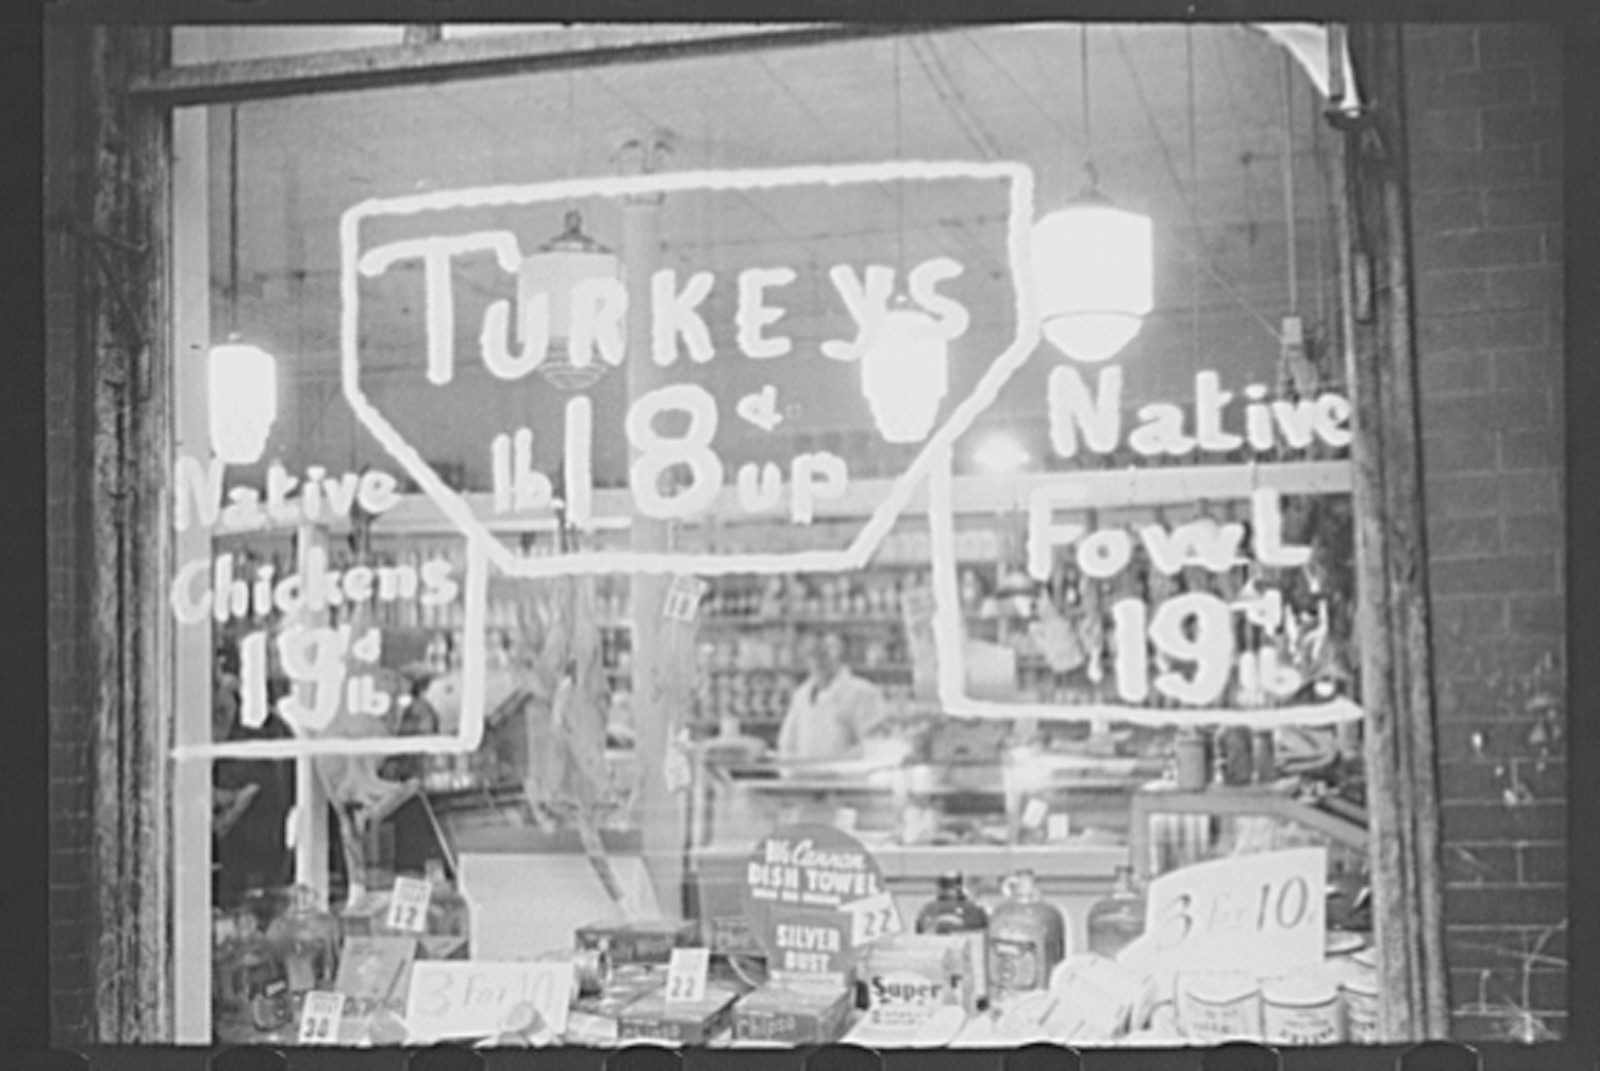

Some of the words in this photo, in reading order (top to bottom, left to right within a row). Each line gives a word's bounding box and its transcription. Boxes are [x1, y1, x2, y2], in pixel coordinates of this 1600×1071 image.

[358, 230, 970, 385] TURKEYS
[1048, 363, 1352, 459] Native
[173, 455, 399, 533] Native
[737, 451, 848, 524] up
[170, 546, 459, 625] Chickens
[747, 861, 800, 890] DISH
[805, 868, 879, 897] TOWEL
[775, 922, 841, 952] SILVER
[1155, 892, 1195, 951] 3
[414, 969, 454, 1017] 3
[870, 974, 943, 1004] Super
